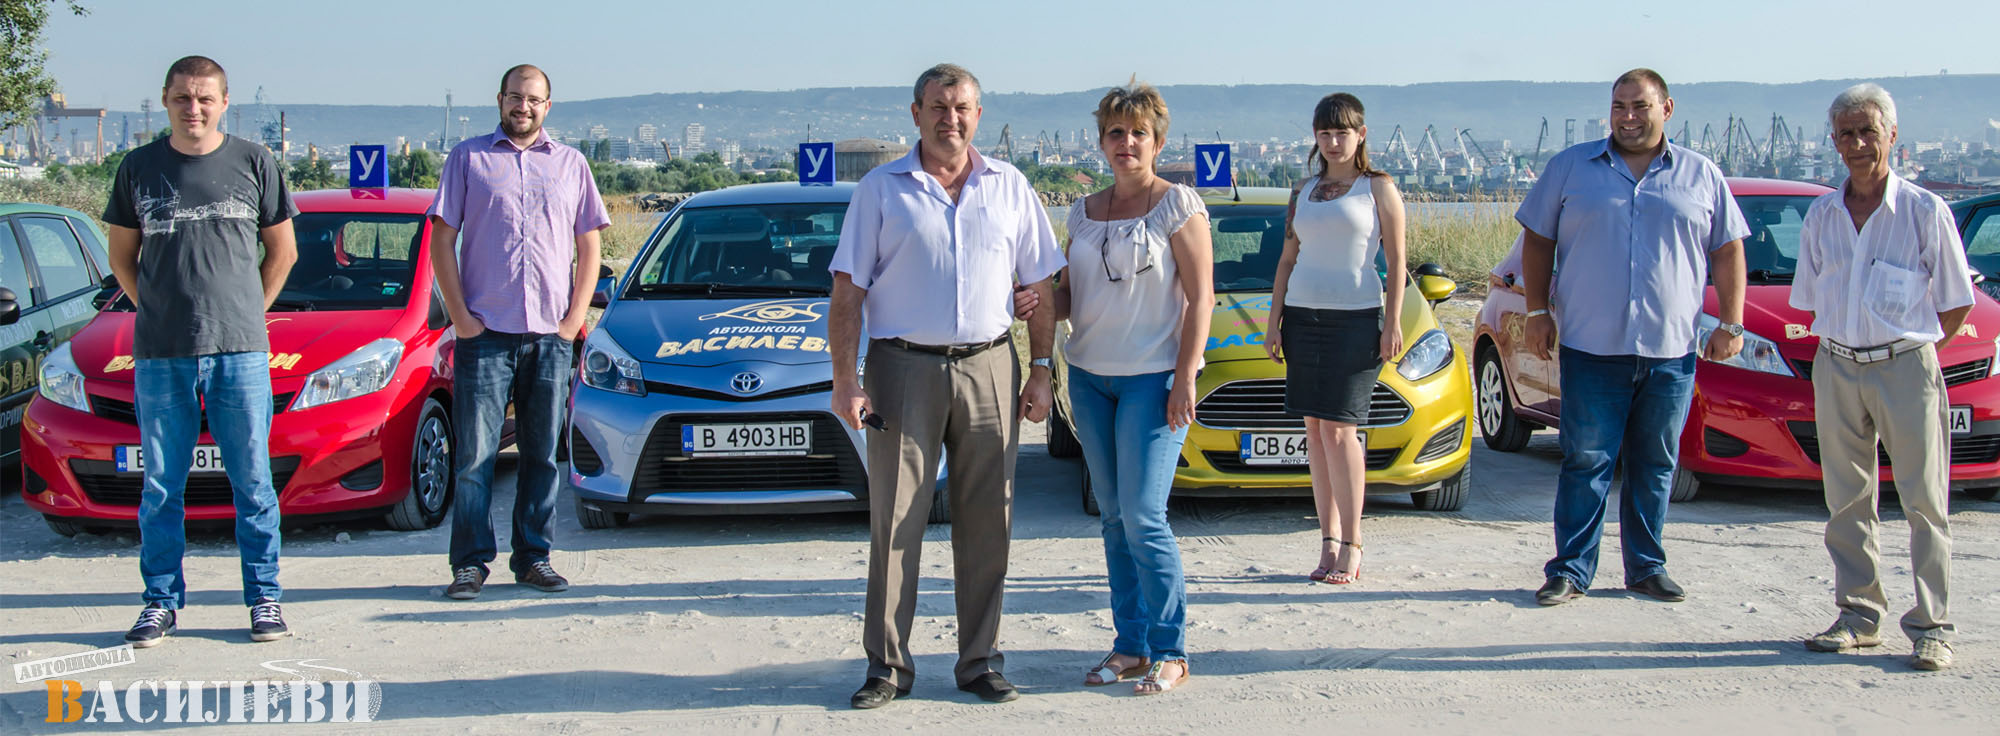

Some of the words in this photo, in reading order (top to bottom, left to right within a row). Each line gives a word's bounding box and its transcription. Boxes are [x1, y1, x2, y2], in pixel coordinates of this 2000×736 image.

[708, 325, 807, 335] АВТОШКОЛА
[703, 428, 716, 448] B
[727, 427, 776, 448] 4903
[779, 426, 806, 447] HB
[1254, 437, 1280, 456] CB
